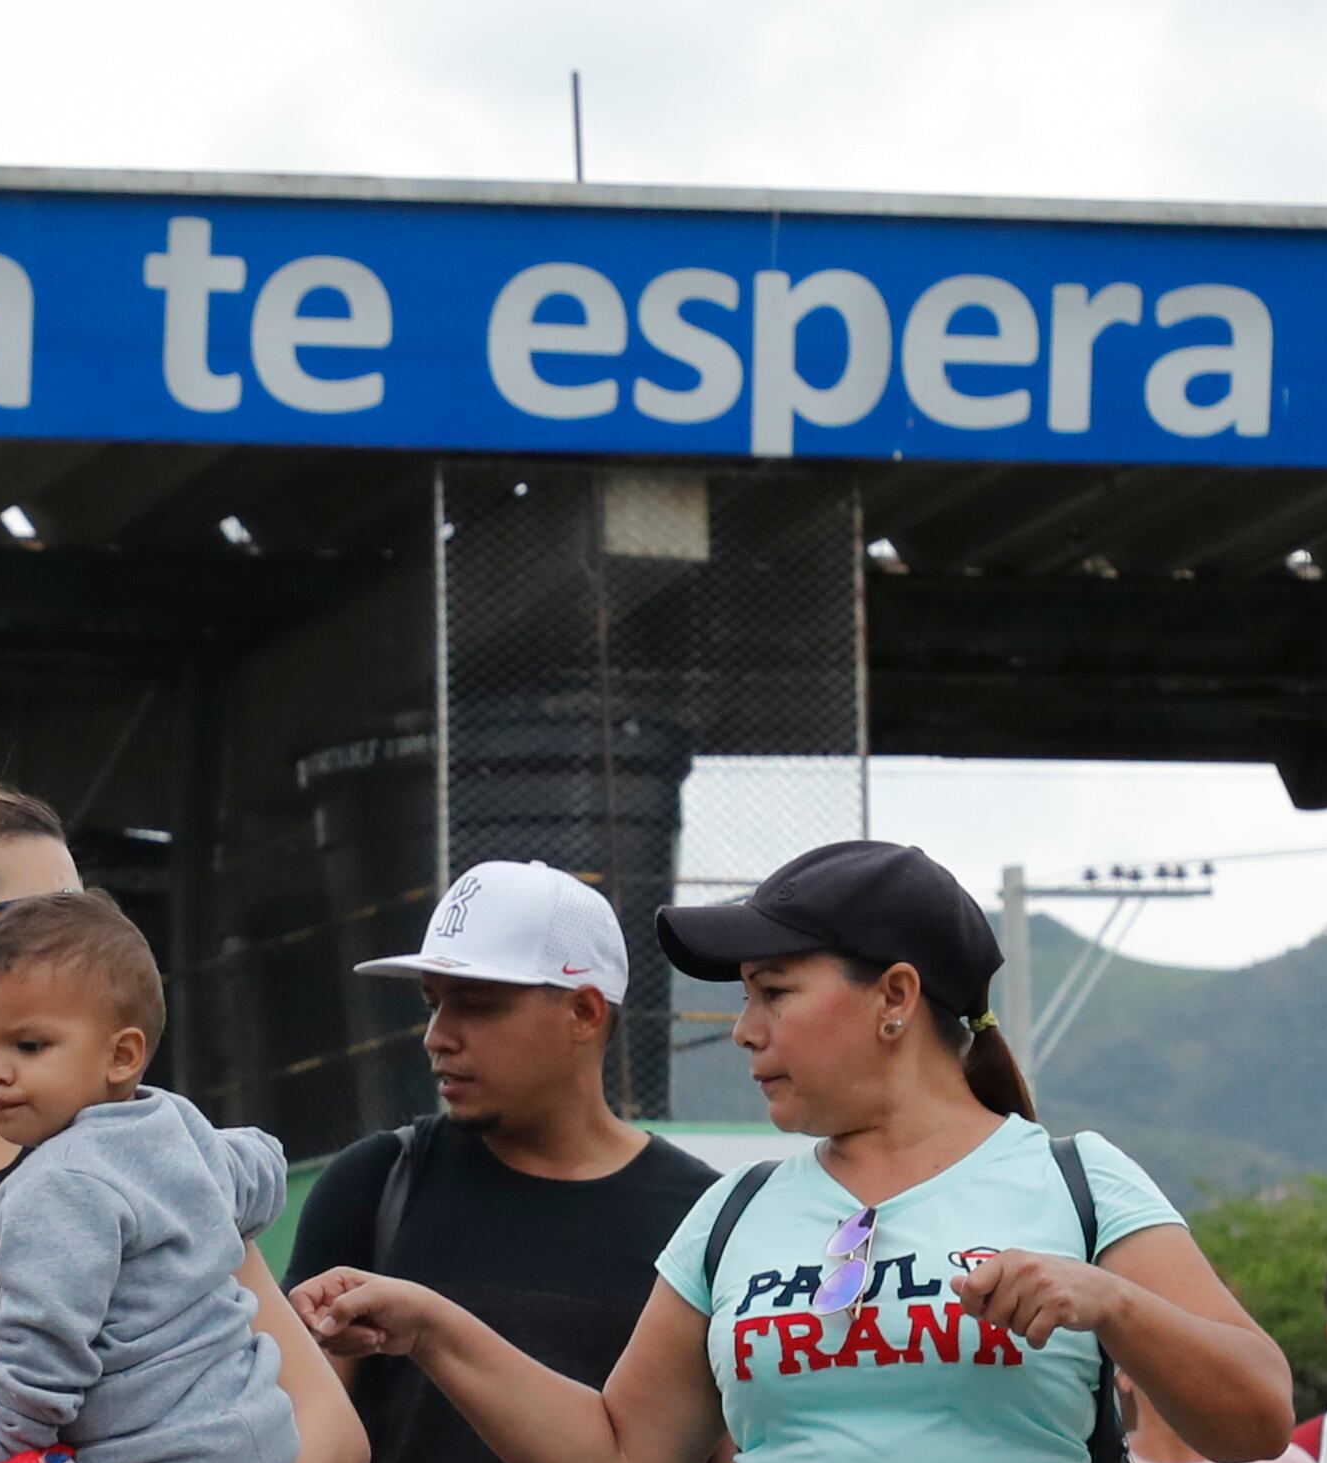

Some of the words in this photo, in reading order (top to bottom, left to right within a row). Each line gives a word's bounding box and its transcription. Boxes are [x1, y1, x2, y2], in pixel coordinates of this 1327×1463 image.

[143, 217, 394, 414] te
[487, 261, 1274, 458] espera
[733, 1303, 1022, 1381] FRANK
